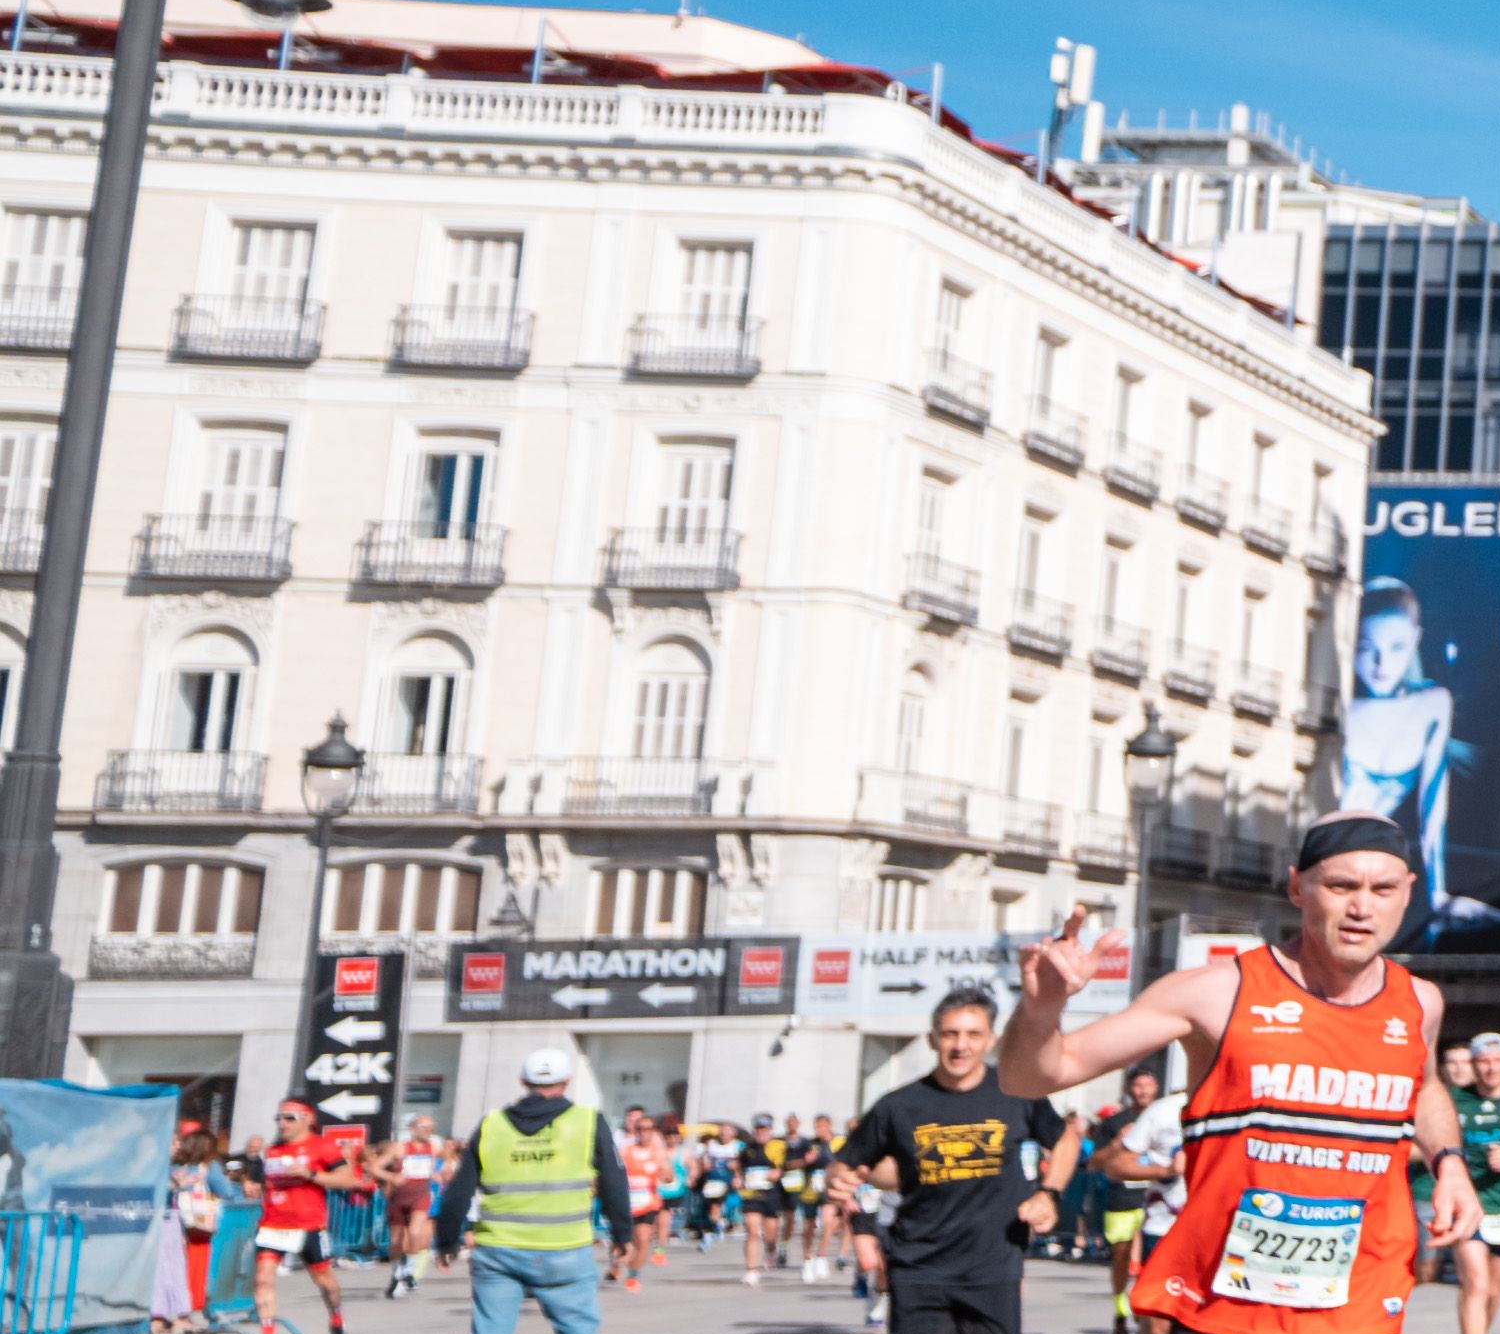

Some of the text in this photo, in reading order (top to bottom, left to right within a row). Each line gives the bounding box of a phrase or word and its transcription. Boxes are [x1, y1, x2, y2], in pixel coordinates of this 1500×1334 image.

[523, 947, 727, 980] MARATHON
[859, 947, 927, 967] HALF
[305, 1051, 394, 1085] 42K
[1250, 1063, 1415, 1112] MADRID
[1246, 1137, 1392, 1174] VINTAGE RUN
[1289, 1204, 1350, 1221] ZURICH
[1252, 1229, 1339, 1263] 22723
